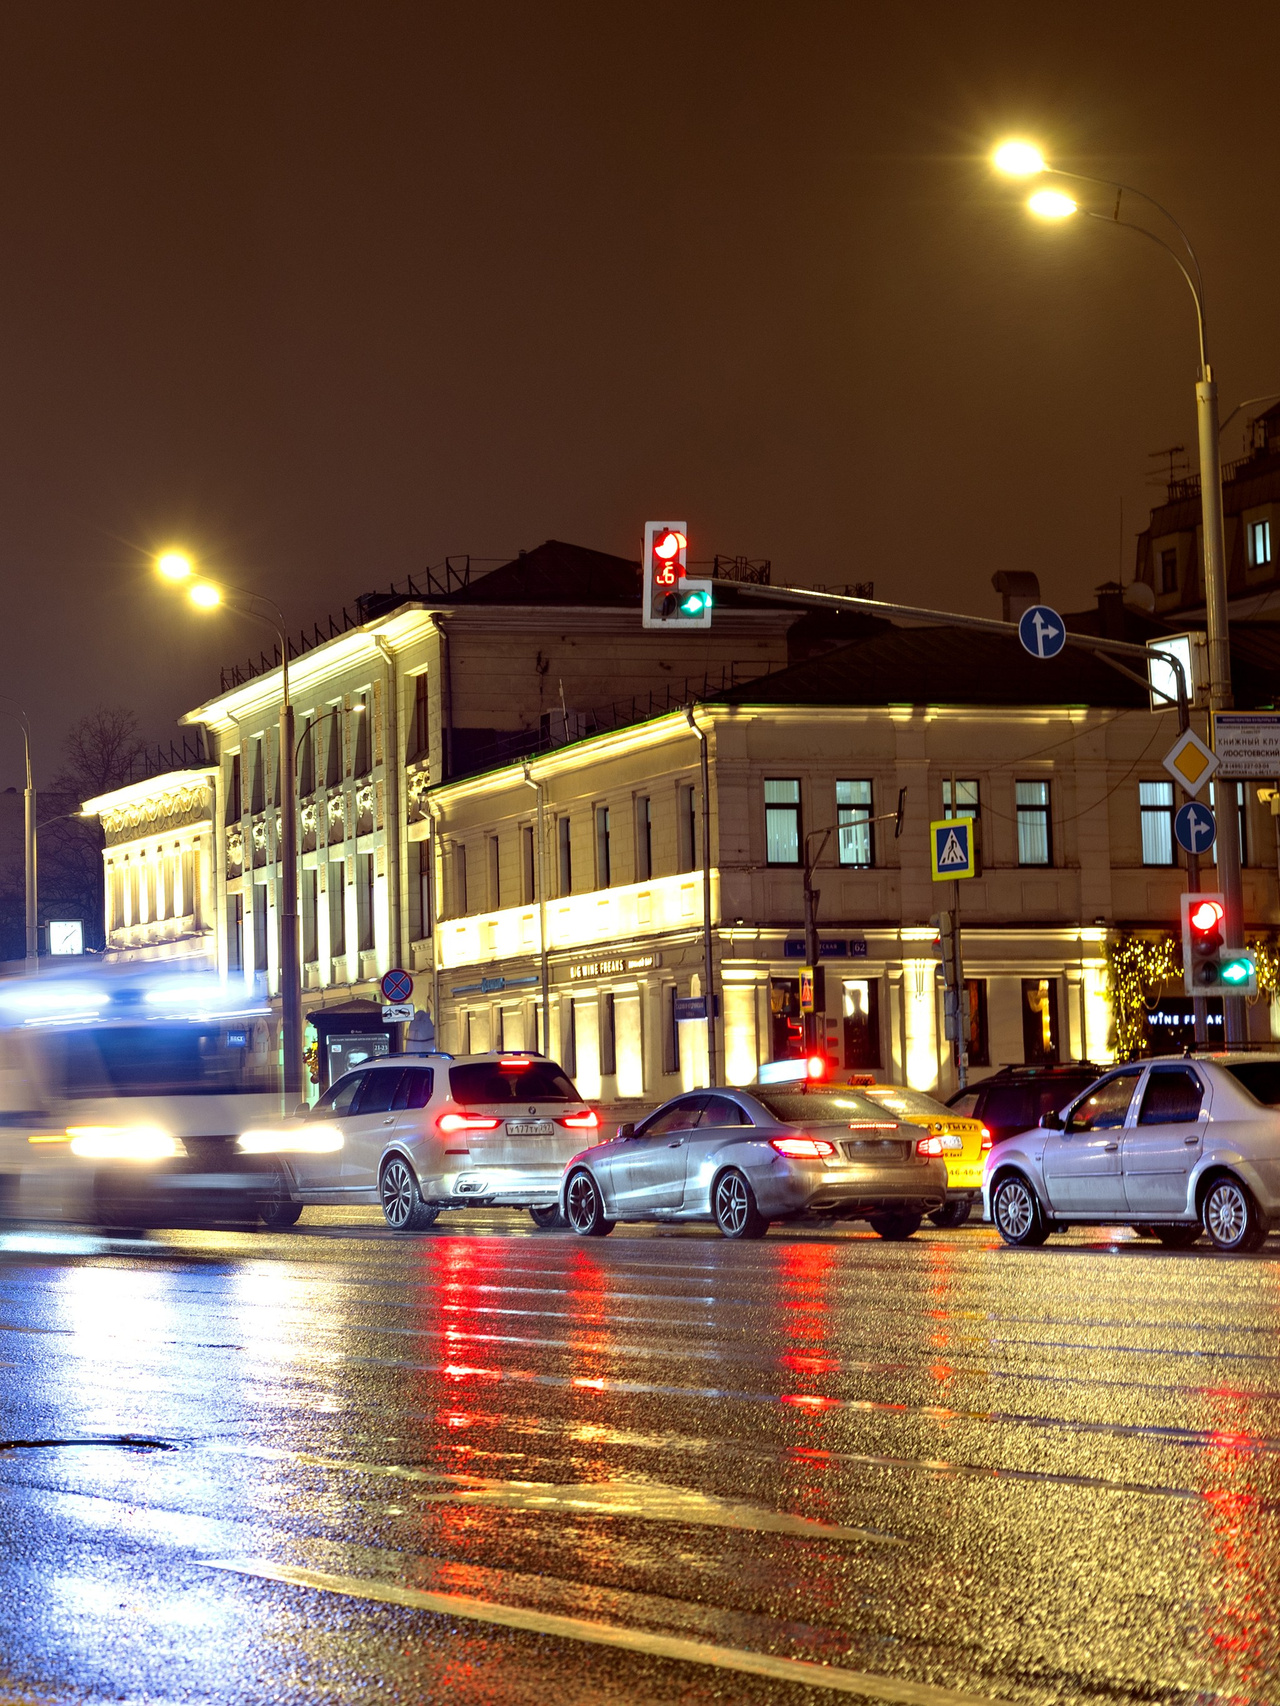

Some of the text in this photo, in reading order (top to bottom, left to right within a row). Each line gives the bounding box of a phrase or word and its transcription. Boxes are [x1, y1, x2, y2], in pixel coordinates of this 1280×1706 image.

[1218, 737, 1280, 746] КНИЖНЫЙ КЛУ
[854, 943, 866, 952] 62
[582, 963, 599, 977] WINE
[600, 959, 624, 974] FREAKS
[1148, 1012, 1179, 1025] WINE
